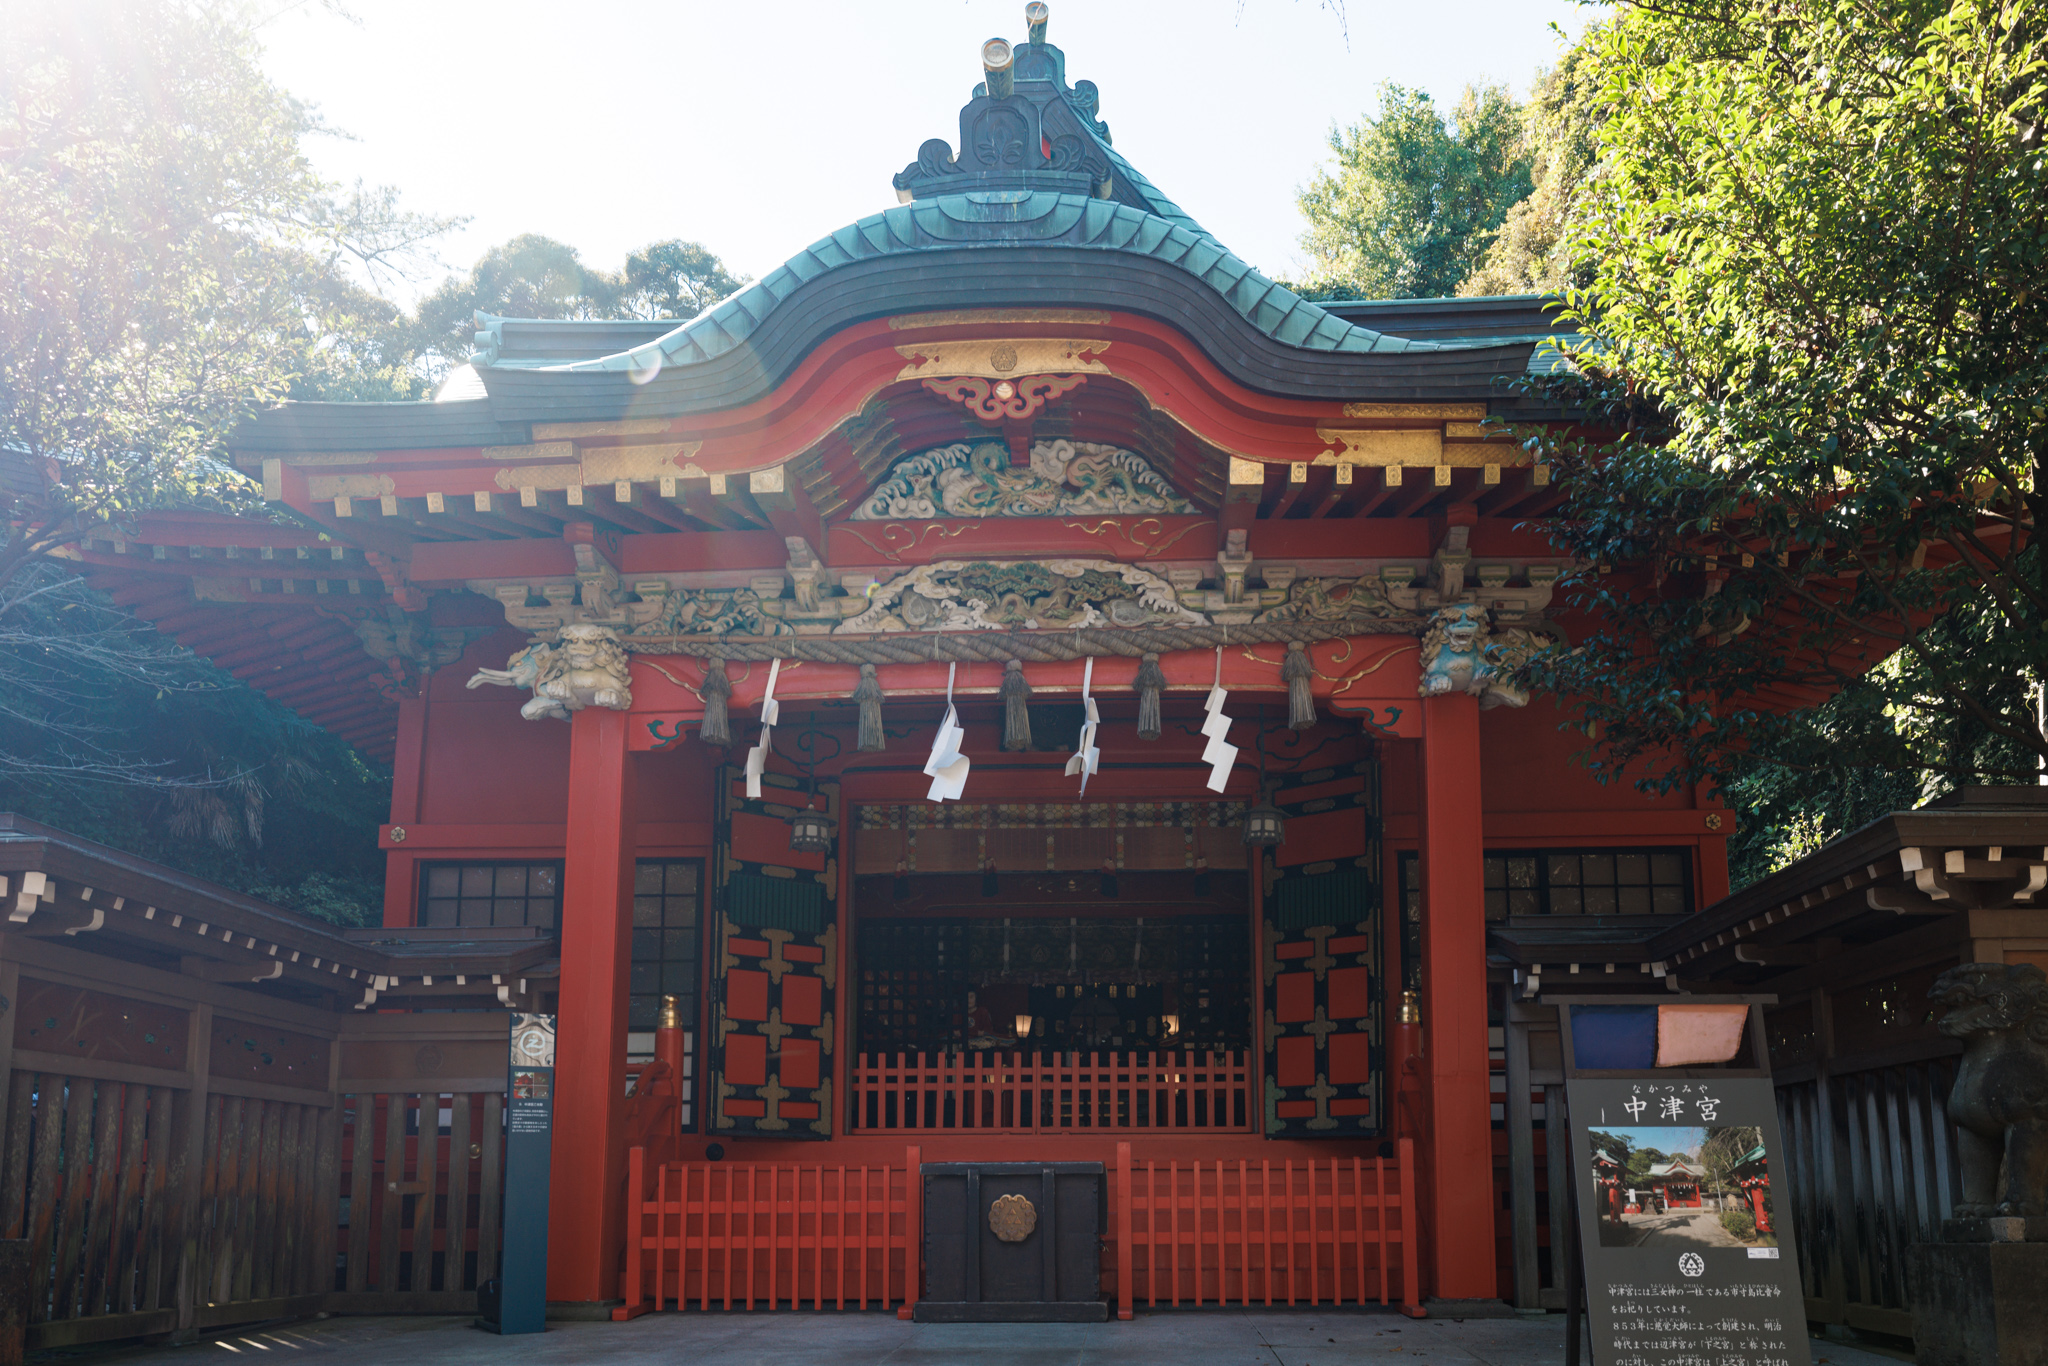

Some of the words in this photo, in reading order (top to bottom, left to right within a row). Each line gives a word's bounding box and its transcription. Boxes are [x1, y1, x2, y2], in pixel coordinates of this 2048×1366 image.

[1633, 1084, 1708, 1094] なかつみや
[1624, 1095, 1721, 1122] 中津宮
